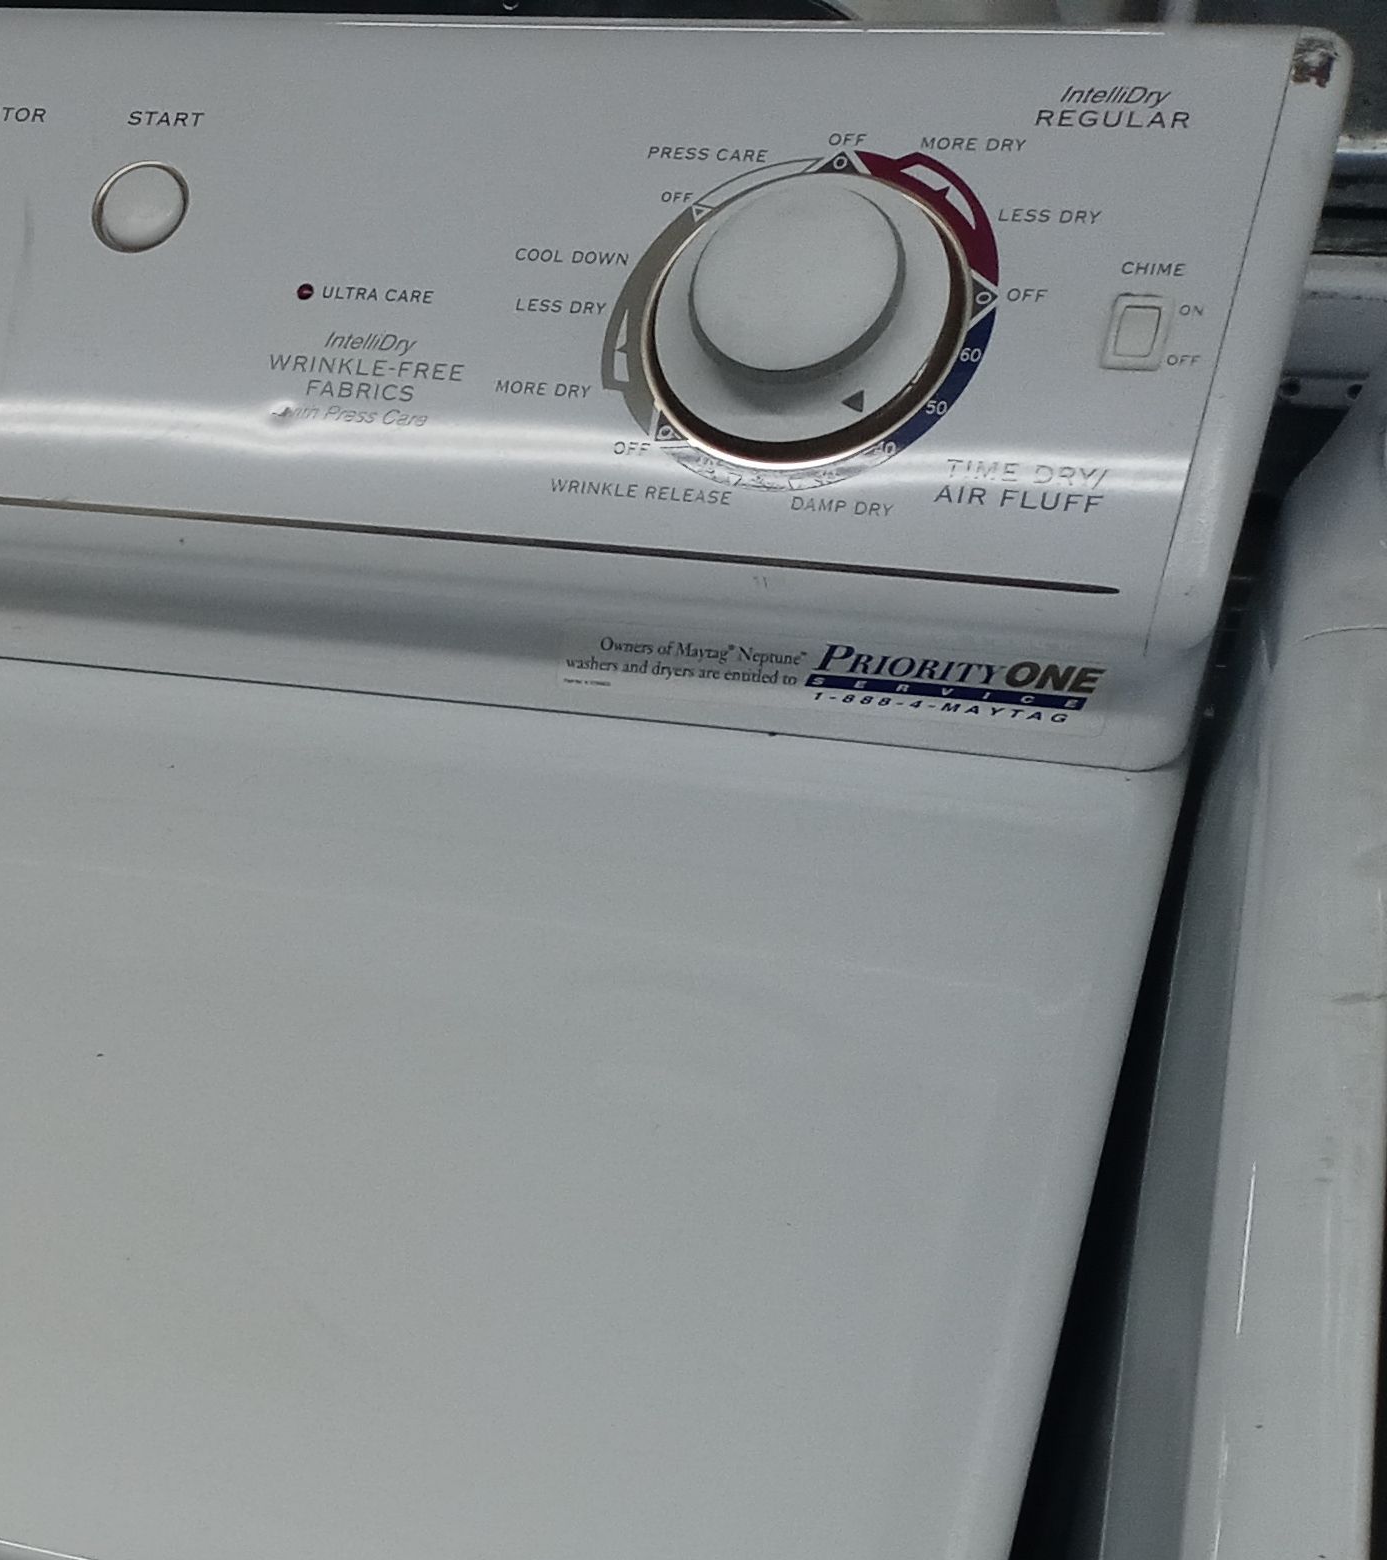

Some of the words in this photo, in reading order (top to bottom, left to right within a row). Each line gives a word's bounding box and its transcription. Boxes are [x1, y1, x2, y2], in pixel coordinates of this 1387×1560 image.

[1059, 85, 1172, 108] IntelliDry
[126, 110, 204, 128] START
[1034, 108, 1191, 130] REGULAR
[828, 132, 868, 147] OFF
[920, 136, 978, 151] MORE
[985, 138, 1027, 153] DRY
[647, 145, 710, 161] PRESS
[716, 148, 769, 163] CARE
[660, 191, 693, 203] OFF
[997, 207, 1052, 224] LESS
[1058, 209, 1103, 226] DRY
[515, 248, 564, 263] COOL
[571, 250, 630, 266] DOWN
[1120, 260, 1187, 278] CHIME
[321, 285, 378, 302] ULTRA
[385, 288, 434, 305] CARE
[1006, 287, 1048, 303] OFF
[515, 298, 562, 314] LESS
[569, 301, 607, 316] DRY
[1178, 304, 1205, 318] ON
[324, 331, 418, 357] IntelliDry
[959, 346, 982, 363] 60
[1166, 354, 1201, 367] OFF
[269, 354, 466, 382] WRINKLE-FREE
[305, 379, 415, 402] FABRICS
[495, 379, 548, 397] MORE
[554, 383, 592, 399] DRY
[324, 405, 378, 424] Press
[382, 408, 429, 427] Care
[925, 400, 949, 416] 50
[613, 440, 652, 456] OFF
[946, 457, 1021, 483] TIME
[550, 477, 639, 499] WRINKLE
[644, 486, 733, 506] RELEASE
[933, 484, 987, 506] AIR
[1000, 488, 1105, 514] FLUFF
[790, 495, 847, 513] DAMP
[853, 500, 896, 517] DRY
[600, 636, 654, 656] Owners
[657, 641, 674, 655] of
[566, 656, 619, 672] washers
[622, 659, 648, 674] and
[651, 660, 695, 682] dryers
[698, 669, 720, 680] are
[724, 667, 778, 685] entitled
[782, 674, 798, 686] to
[807, 677, 1081, 709] SERVICE
[812, 692, 1070, 724] 1-888-4-MAYTAG
